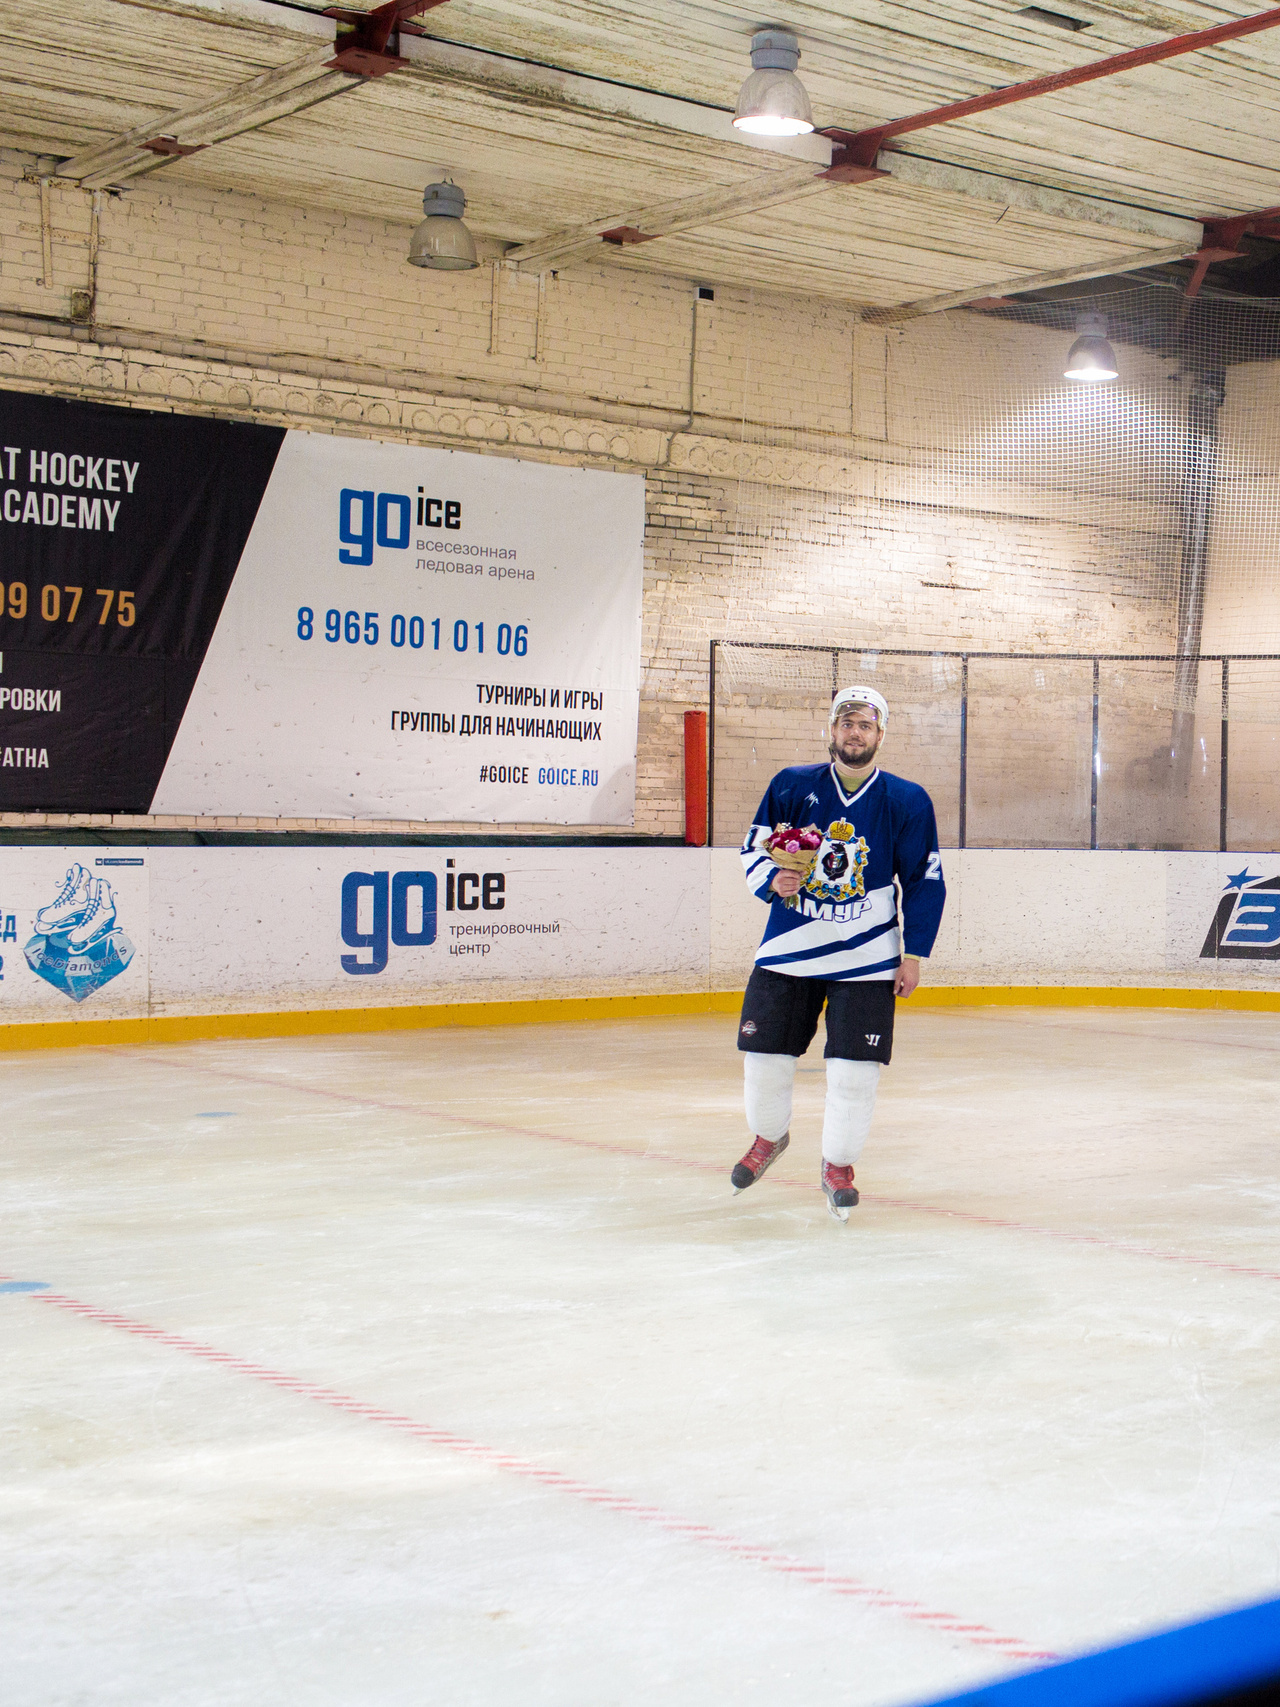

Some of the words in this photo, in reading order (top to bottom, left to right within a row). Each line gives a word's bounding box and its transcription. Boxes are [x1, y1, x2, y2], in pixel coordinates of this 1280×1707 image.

[0, 446, 21, 480] T
[30, 449, 140, 493] HOCKEY
[0, 488, 121, 532] CADEMY
[339, 487, 411, 566] go
[416, 486, 461, 530] ice
[416, 539, 517, 560] всесезонная
[415, 558, 483, 575] ледовая
[488, 563, 535, 580] арена
[41, 584, 83, 623] 07
[96, 589, 136, 627] 75
[297, 607, 314, 641] 8
[325, 609, 379, 645] 965
[391, 614, 440, 650] 001
[454, 619, 484, 654] 01
[497, 623, 528, 657] 06
[476, 684, 546, 708] ТУРНИРЫ
[550, 689, 560, 708] И
[564, 690, 603, 711] ИГРЫ
[391, 710, 455, 733] ГРУППЫ
[459, 714, 492, 736] ДЛЯ
[496, 716, 602, 742] НАЧИНАЮЩИХ
[0, 747, 49, 769] АТНА
[479, 765, 529, 784] #GOICE
[538, 767, 599, 786] GOICE.RU
[340, 870, 438, 975] go
[446, 858, 505, 911] ice
[449, 920, 560, 938] тренировочный
[32, 946, 128, 972] IceDiamonds
[449, 943, 491, 956] центр
